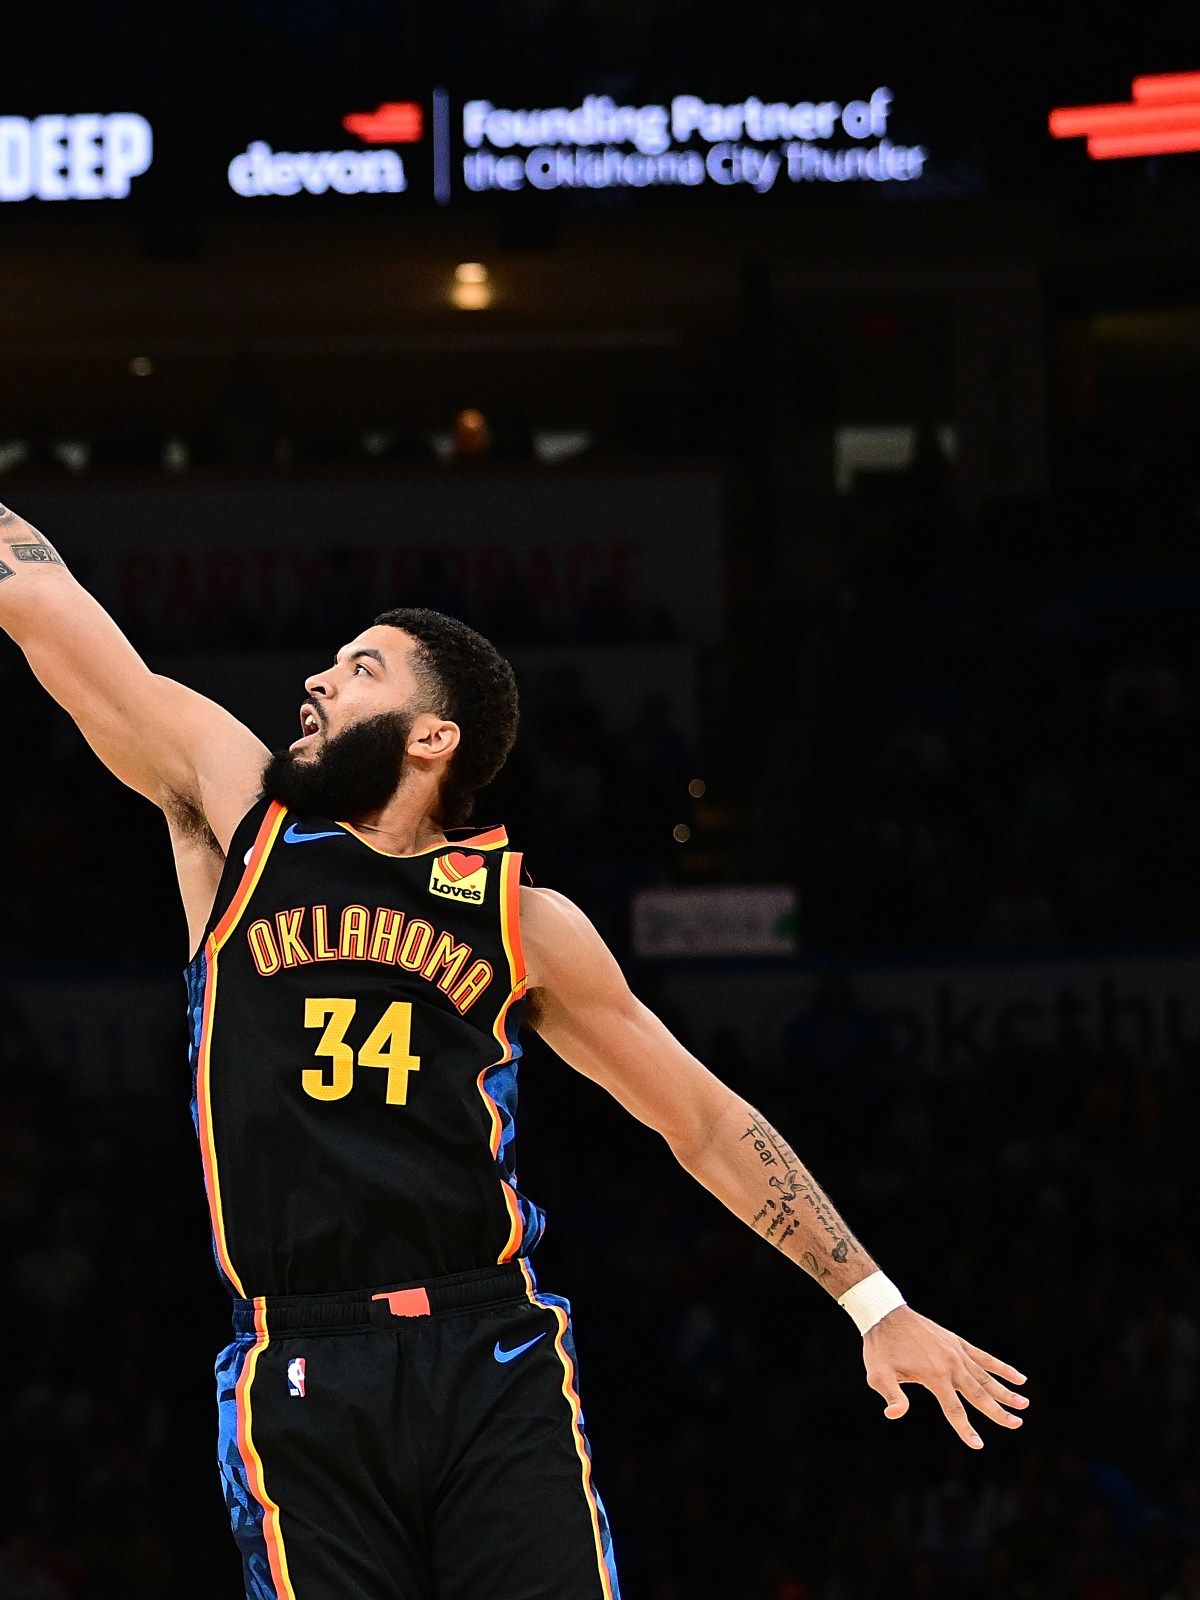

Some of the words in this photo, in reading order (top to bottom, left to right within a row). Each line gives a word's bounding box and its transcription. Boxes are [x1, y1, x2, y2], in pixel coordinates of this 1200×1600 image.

[463, 94, 670, 155] Founding
[671, 95, 841, 142] Partner
[842, 86, 895, 139] of
[228, 140, 408, 197] devon
[463, 147, 526, 191] the
[525, 146, 705, 190] Oklahoma
[706, 141, 782, 193] City
[782, 139, 927, 182] Thunder
[247, 904, 494, 1016] OKLAHOMA
[302, 997, 421, 1106] 34
[739, 1123, 779, 1167] Fear
